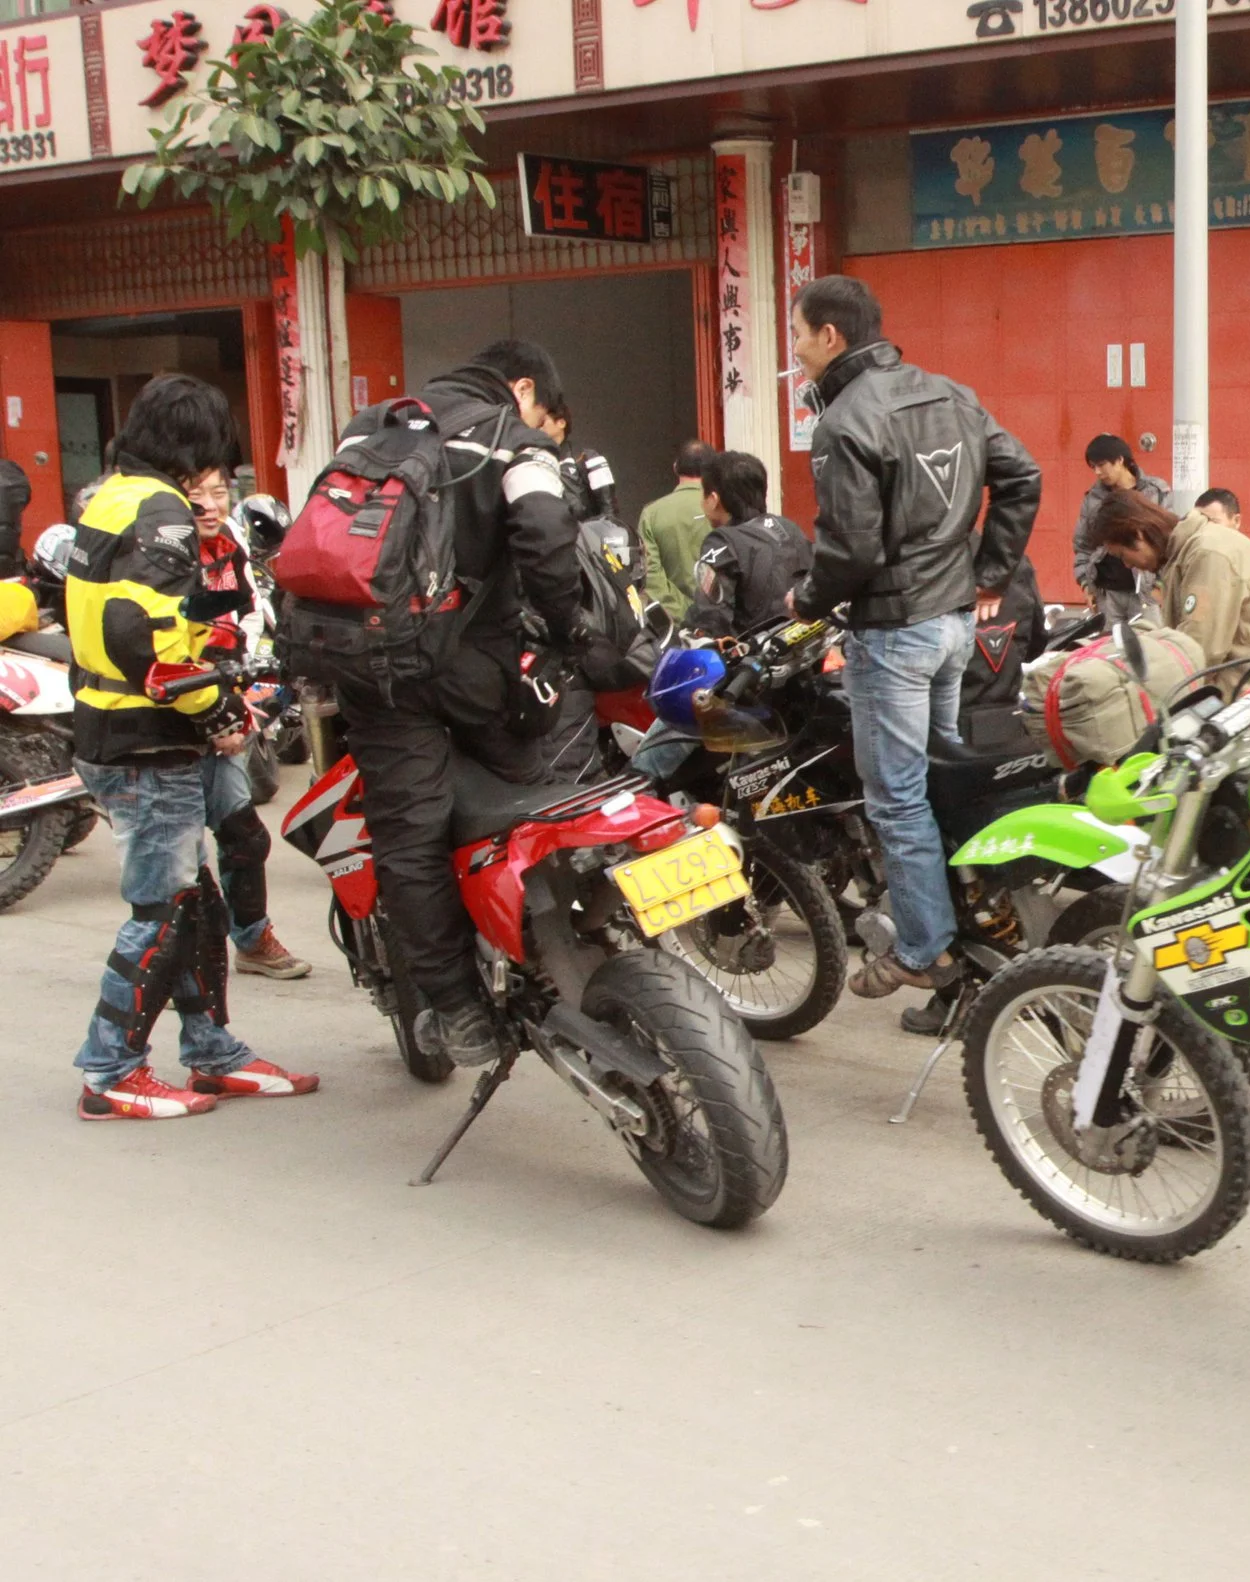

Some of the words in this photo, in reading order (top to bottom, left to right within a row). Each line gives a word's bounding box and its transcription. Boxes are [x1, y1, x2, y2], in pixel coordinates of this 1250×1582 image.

[533, 158, 644, 238] 住宿
[728, 755, 792, 790] Kawasaki
[992, 753, 1048, 780] 250
[1140, 891, 1235, 935] Kawasaki
